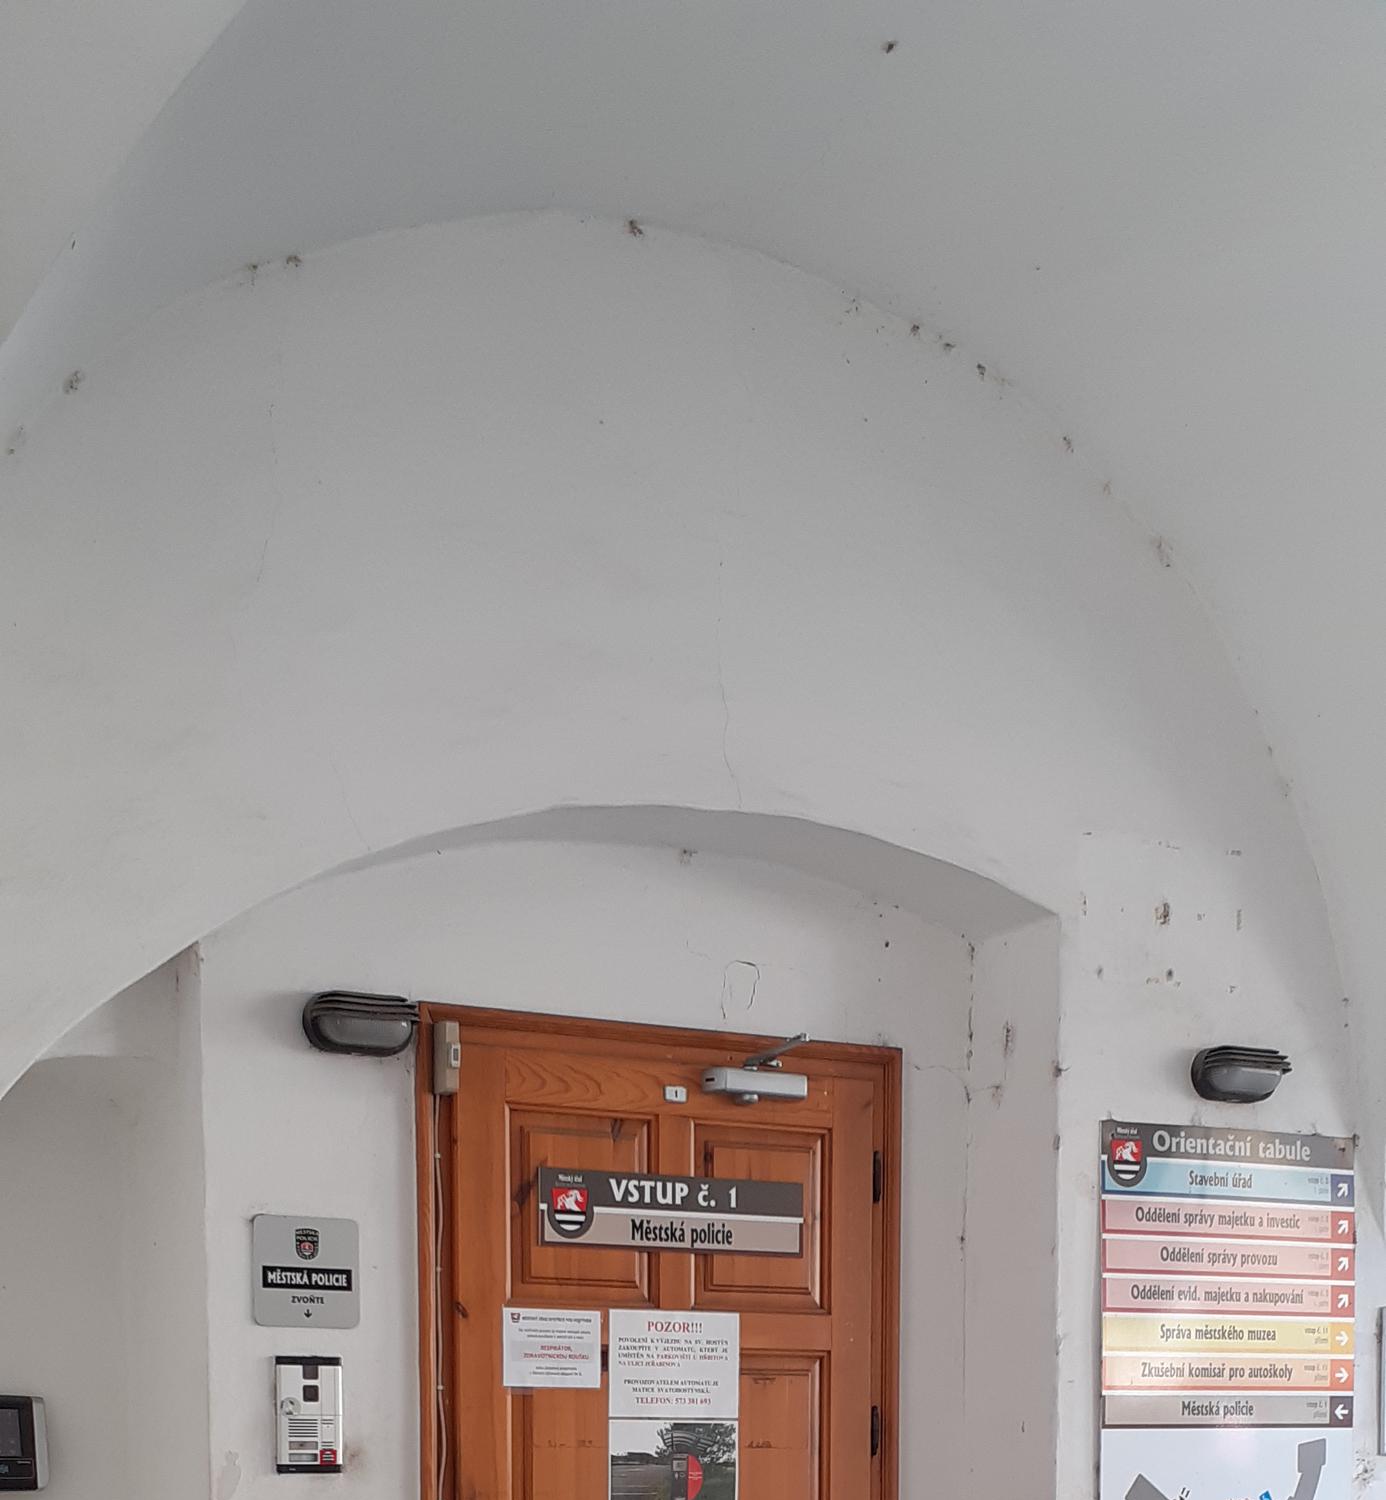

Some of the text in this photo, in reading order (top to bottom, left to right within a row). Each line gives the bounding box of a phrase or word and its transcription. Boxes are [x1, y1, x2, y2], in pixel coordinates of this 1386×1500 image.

[674, 1089, 679, 1099] 1
[1152, 1130, 1311, 1161] Orientační tabule
[1189, 1171, 1253, 1189] Stavební úřad
[609, 1178, 737, 1208] VSTUP č. 1
[1135, 1206, 1180, 1223] Oddělení
[1184, 1209, 1214, 1227] správy
[1218, 1211, 1255, 1229] majetku
[1258, 1216, 1264, 1228] a
[1267, 1211, 1301, 1229] investic
[631, 1219, 733, 1248] Městská policie
[1160, 1246, 1278, 1268] Oddělení správy provozu
[267, 1269, 348, 1287] MĚSTSKÁ POLICIE
[291, 1294, 325, 1304] ZVOŇTE
[1131, 1284, 1175, 1301] Oddělení
[1178, 1286, 1201, 1302] evid.
[1204, 1286, 1241, 1305] majetku
[1244, 1292, 1250, 1302] a
[1253, 1288, 1304, 1306] nakupování
[648, 1321, 703, 1333] POZOR!!!
[1160, 1323, 1276, 1343] Správa městského muzea
[1141, 1362, 1293, 1382] Zkušební komisař pro autoškoly
[635, 1396, 673, 1405] TELEFON:
[1182, 1401, 1254, 1419] Městská policie
[1181, 1487, 1190, 1498] 11
